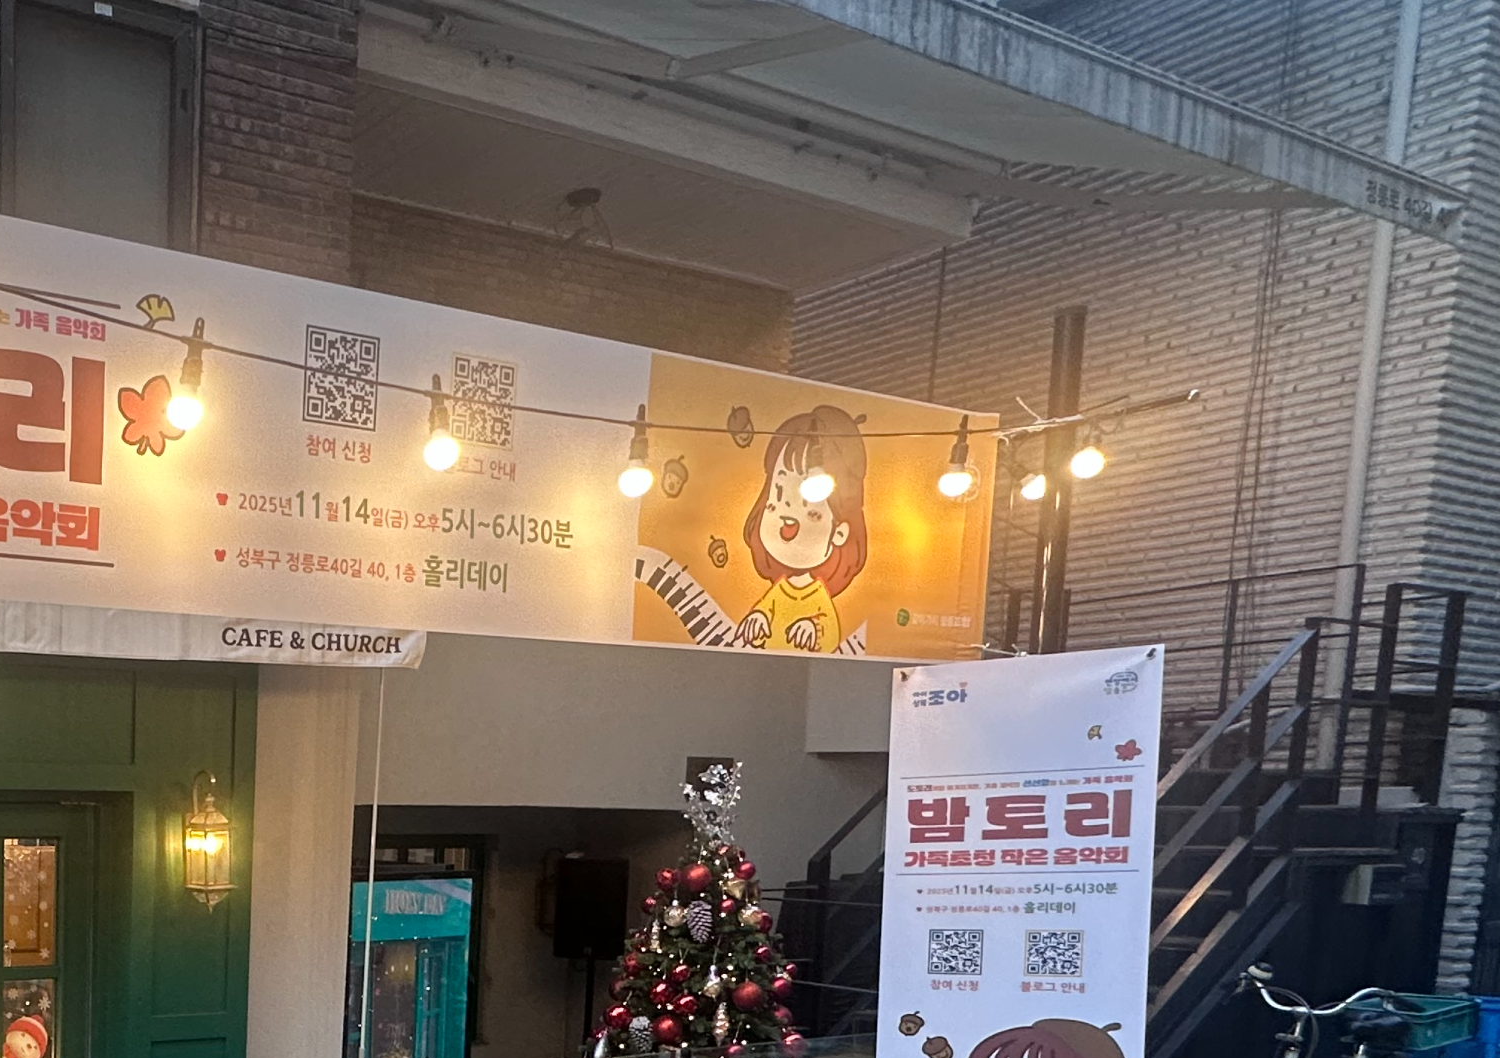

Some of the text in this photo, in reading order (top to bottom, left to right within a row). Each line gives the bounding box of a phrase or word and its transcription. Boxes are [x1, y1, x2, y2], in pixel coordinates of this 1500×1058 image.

[14, 307, 50, 332] 가족
[55, 315, 107, 342] 음악회
[305, 434, 373, 465] 참여 신청
[489, 459, 517, 482] 안내
[235, 546, 509, 593] 성북구 정릉로40길 40, 1층 홀리데이
[221, 626, 403, 654] CAFE & CHURCH
[927, 688, 968, 706] 조아
[907, 789, 1134, 844] 밤토리
[904, 846, 1130, 868] 가족초청 작은 음악회
[1024, 902, 1076, 914] 홀리데이
[1060, 982, 1086, 994] 안내
